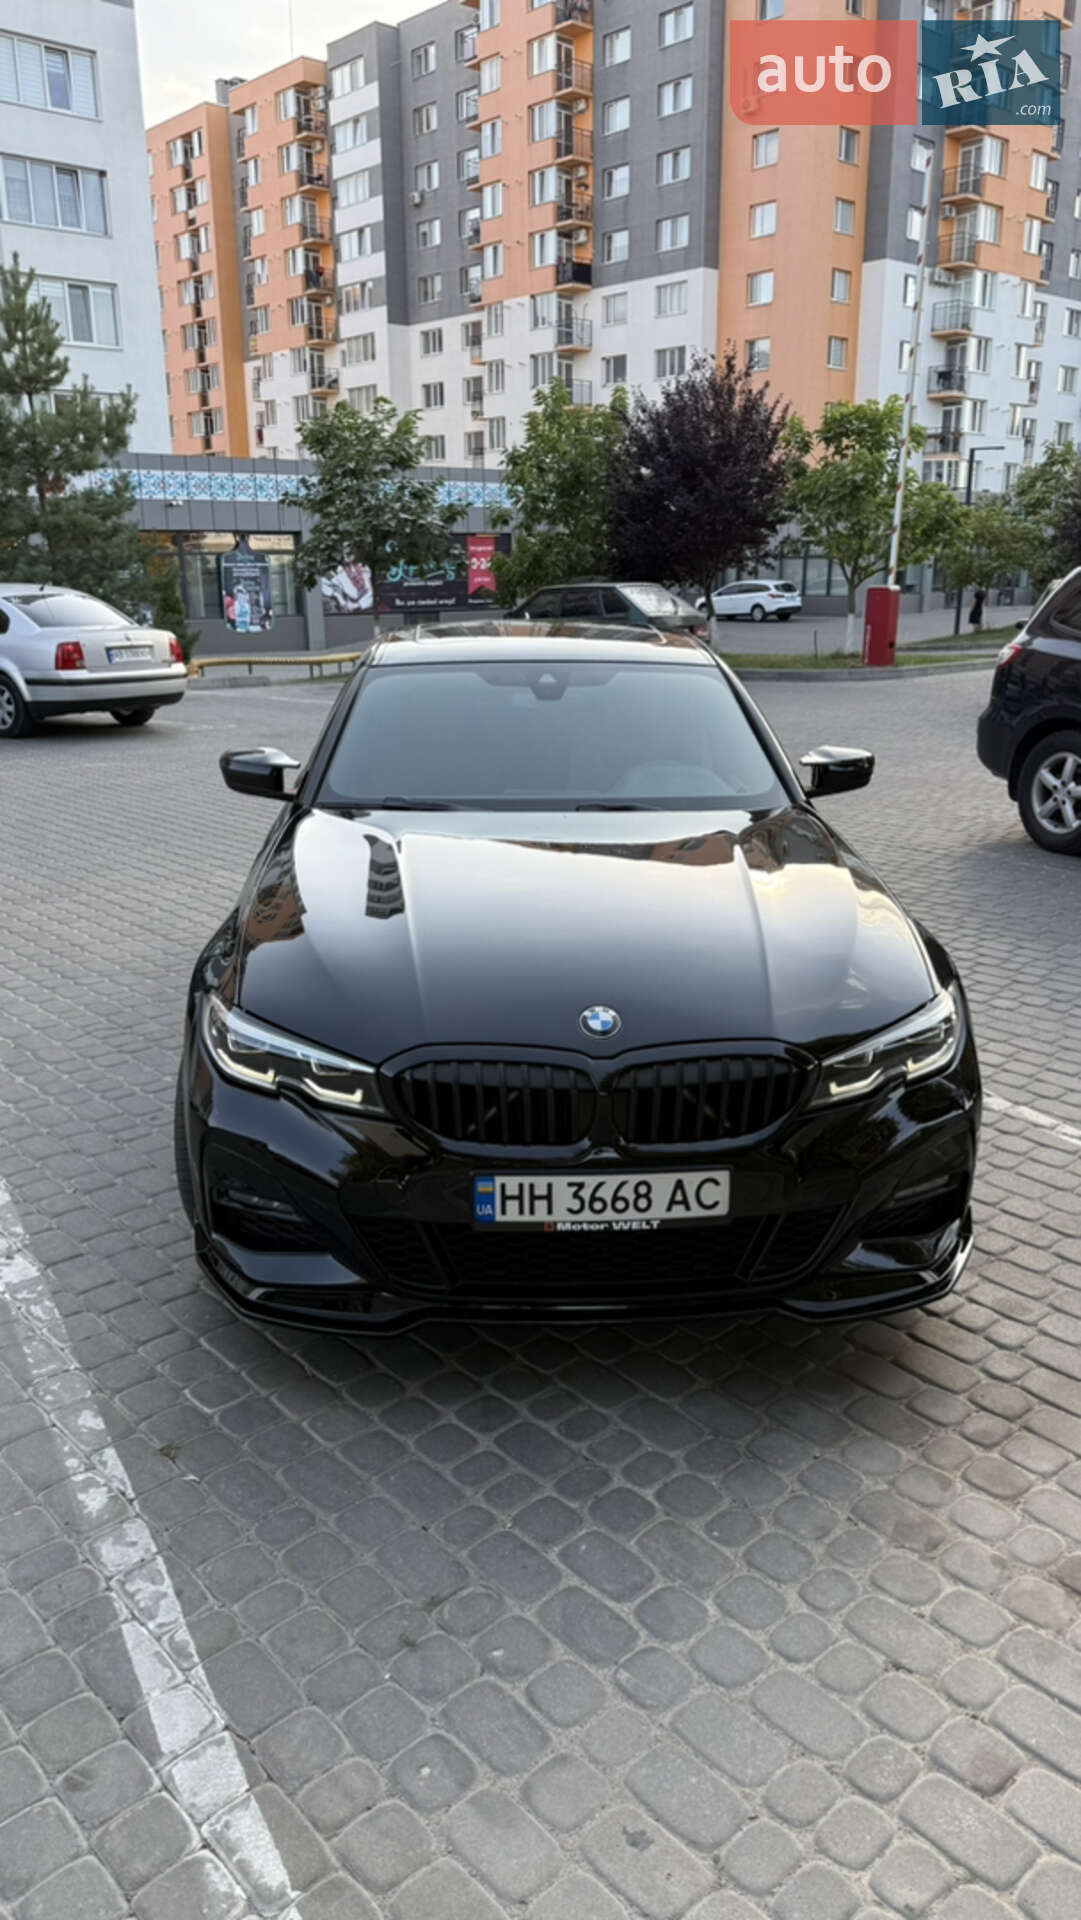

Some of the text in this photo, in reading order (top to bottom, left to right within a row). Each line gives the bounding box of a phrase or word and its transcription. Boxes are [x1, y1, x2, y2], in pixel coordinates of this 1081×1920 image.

[500, 1177, 721, 1216] HH 3668 AC
[476, 1205, 493, 1215] UA
[556, 1220, 660, 1232] Motor WELT
